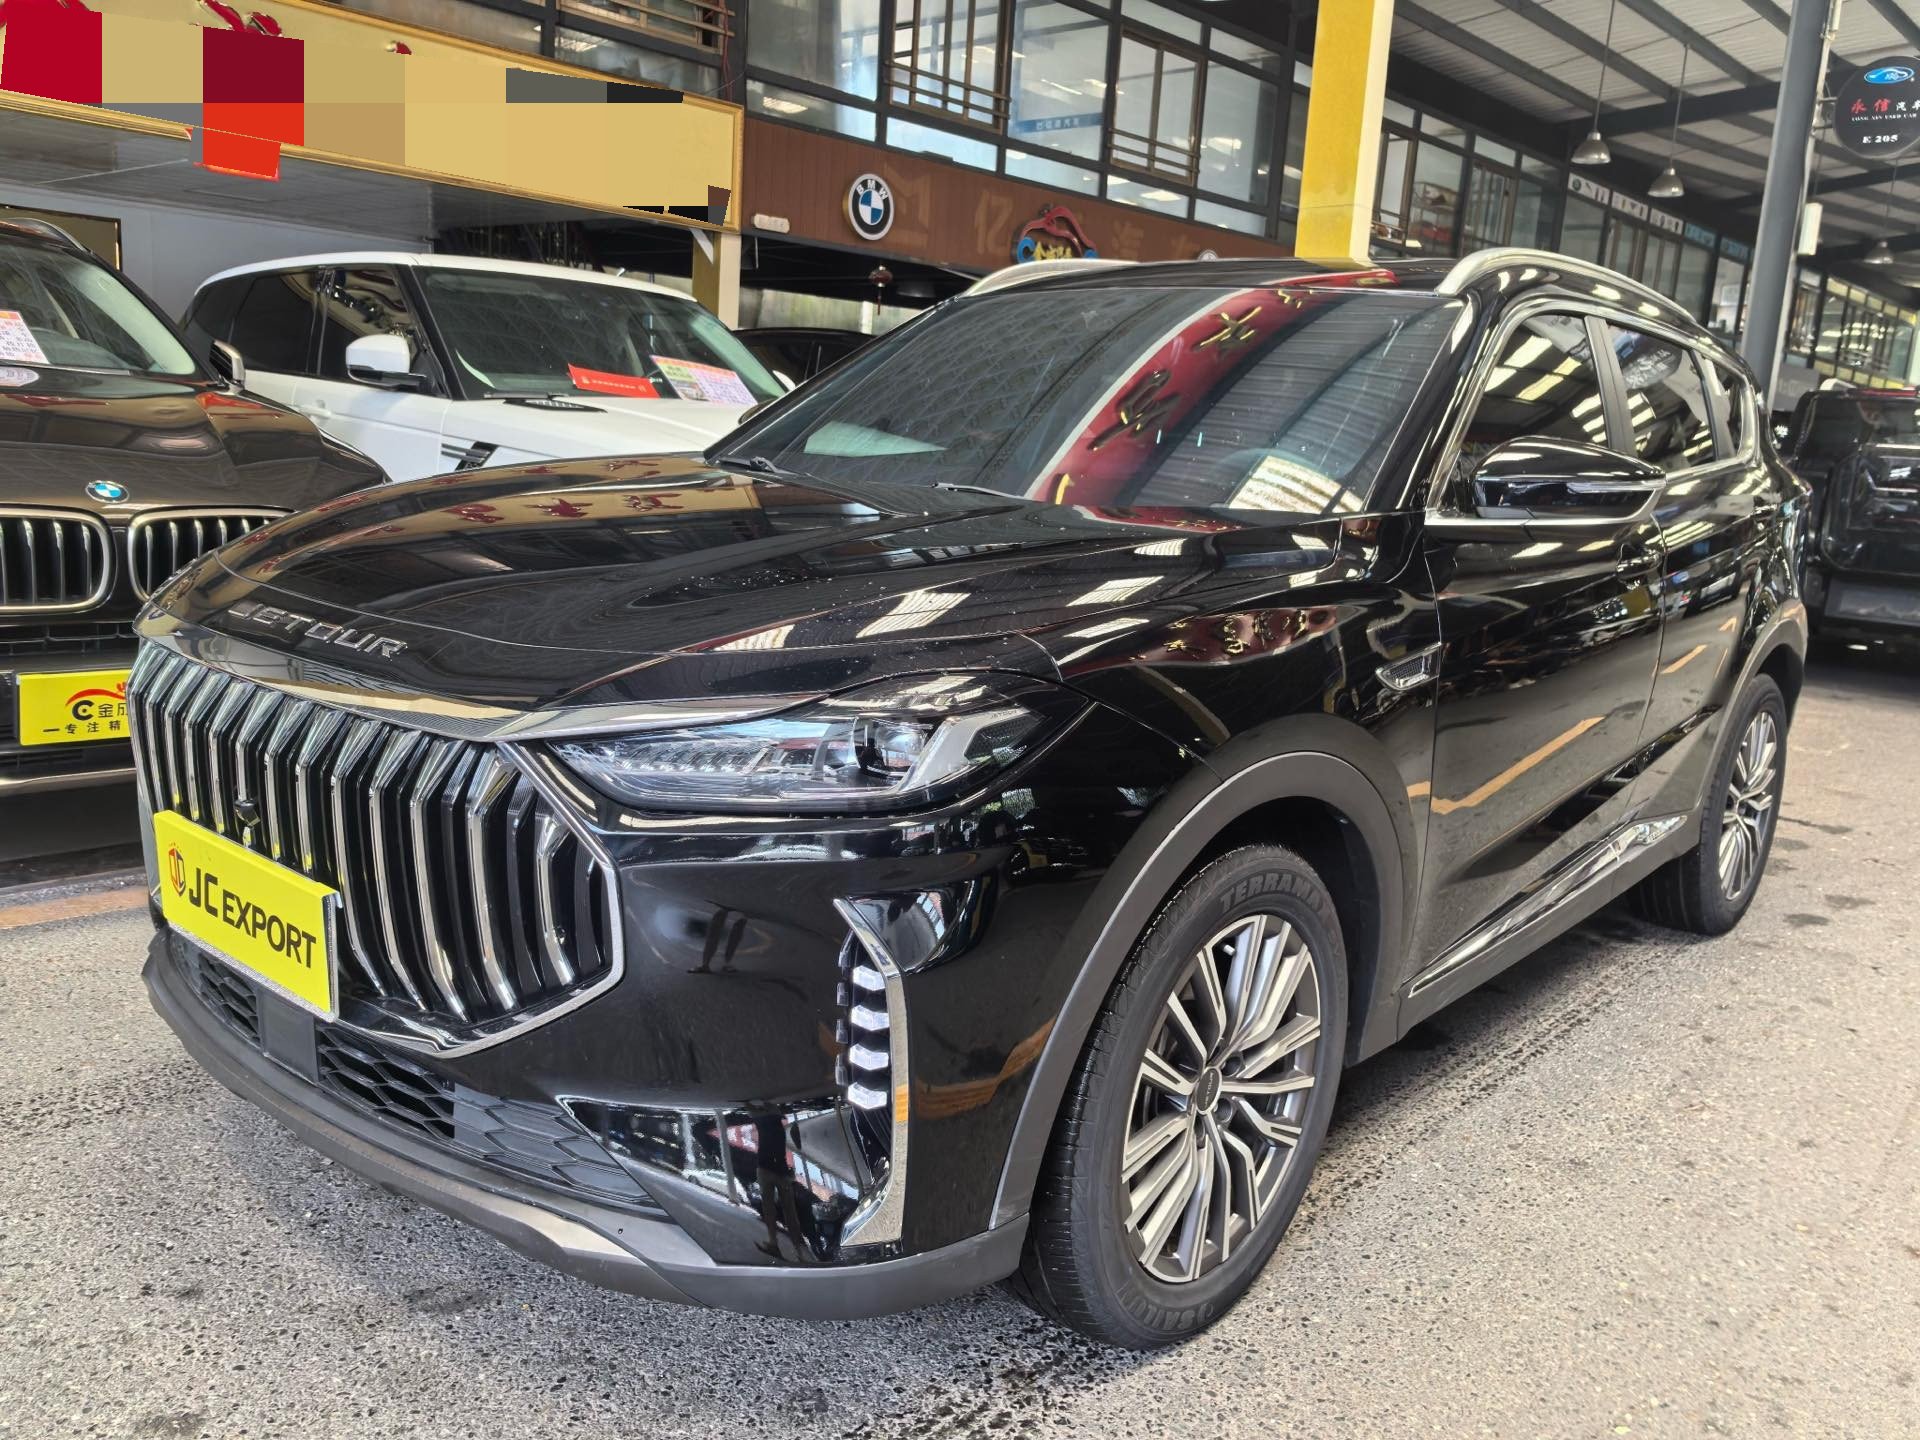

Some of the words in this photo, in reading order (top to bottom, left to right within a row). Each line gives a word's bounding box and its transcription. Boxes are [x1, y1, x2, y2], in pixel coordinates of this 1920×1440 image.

[856, 179, 888, 200] BMW
[227, 601, 408, 661] JETOUR
[188, 867, 219, 918] JC
[222, 889, 317, 969] EXPORT
